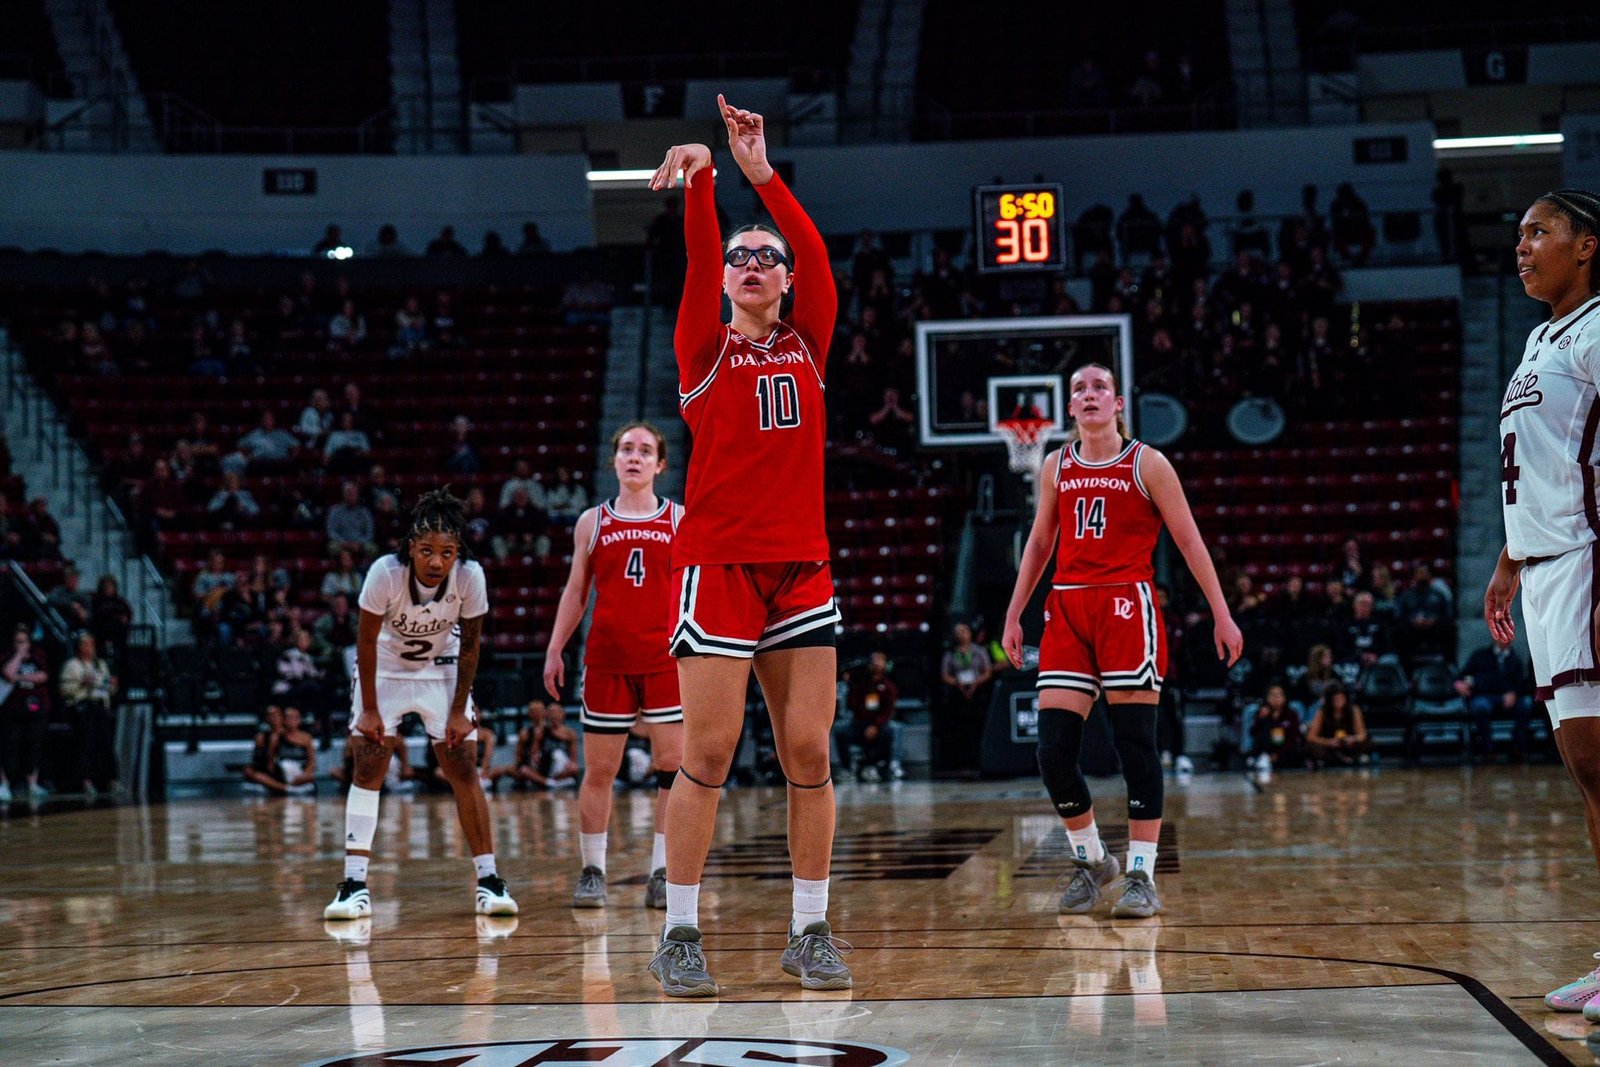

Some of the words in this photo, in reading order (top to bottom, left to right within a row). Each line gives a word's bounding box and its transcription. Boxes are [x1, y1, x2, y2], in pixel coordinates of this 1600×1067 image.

[1486, 50, 1505, 80] G
[643, 84, 667, 114] F
[999, 191, 1055, 219] 6:50
[995, 219, 1049, 264] 30
[755, 373, 801, 430] 10
[1501, 369, 1543, 419] tate
[1060, 477, 1132, 493] DAVIDSON
[1074, 496, 1107, 540] 14
[601, 528, 672, 547] DAVIDSON
[623, 547, 646, 588] 4
[1112, 596, 1135, 620] DC
[392, 613, 453, 637] State
[401, 640, 432, 661] 2
